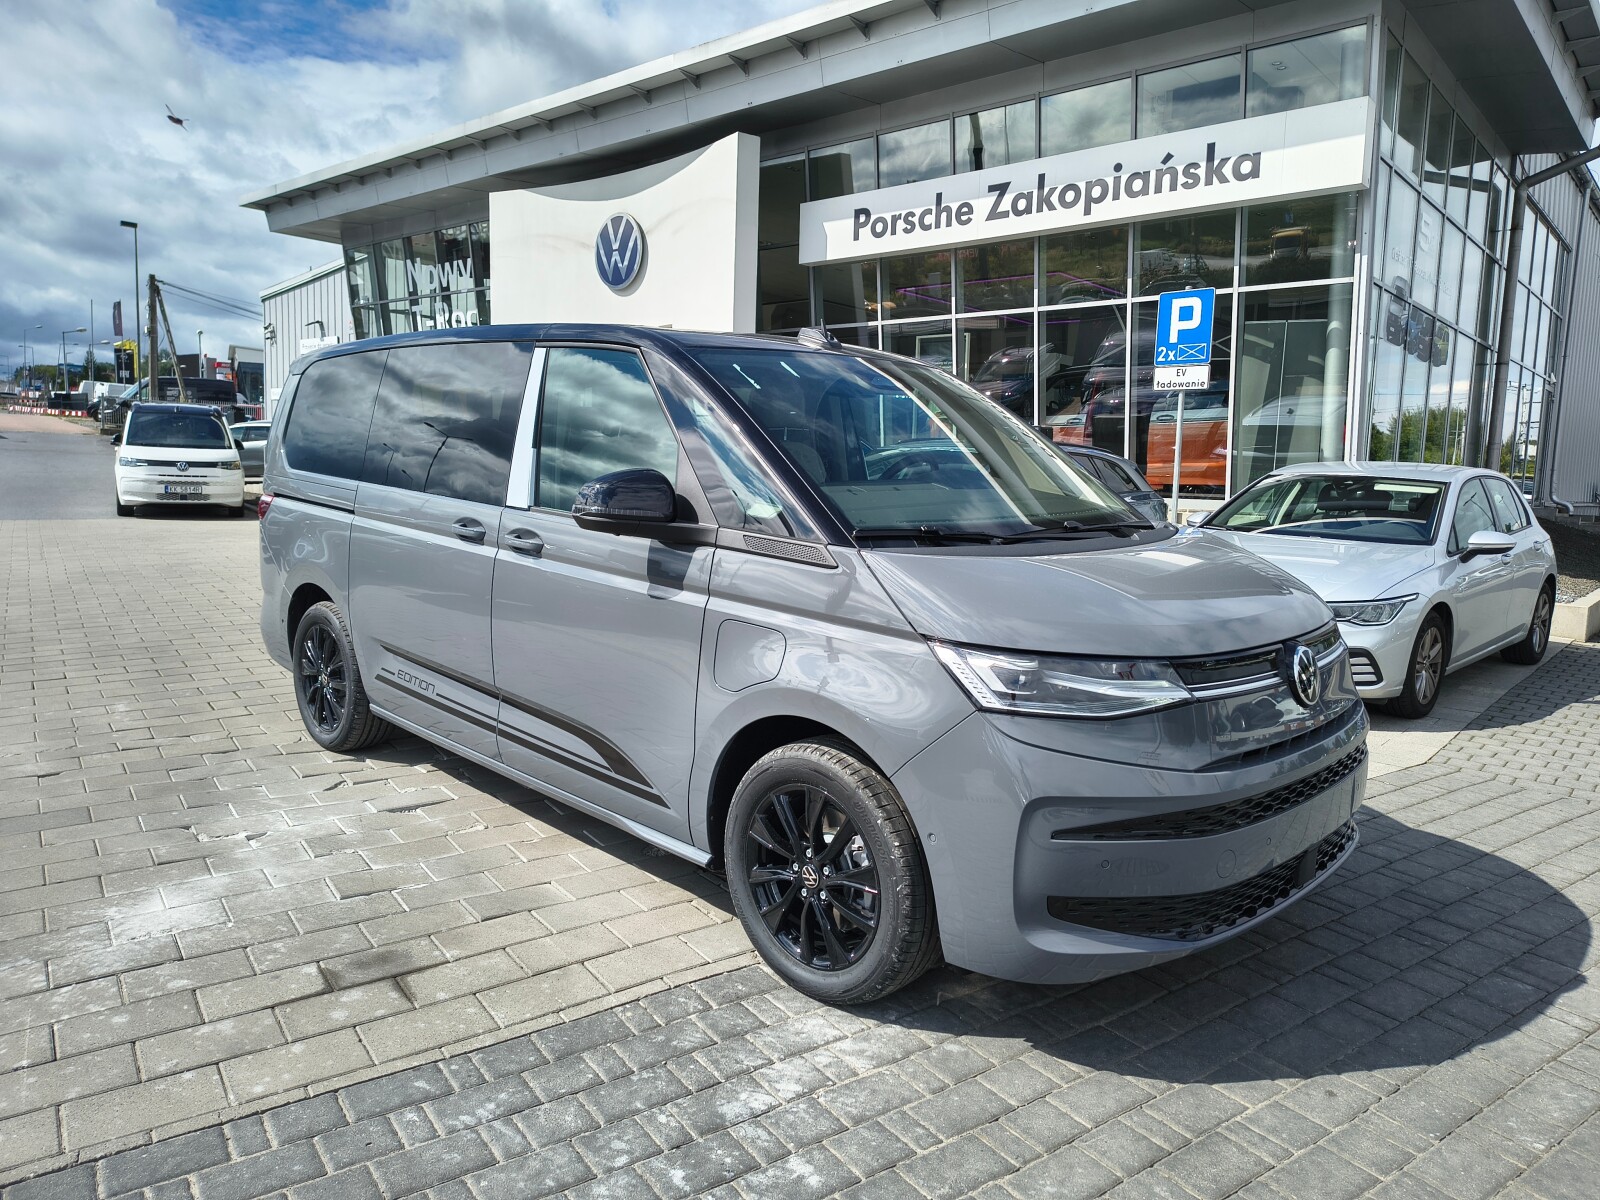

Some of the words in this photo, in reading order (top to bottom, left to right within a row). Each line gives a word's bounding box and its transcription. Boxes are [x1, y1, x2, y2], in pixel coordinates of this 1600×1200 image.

[853, 192, 974, 241] Porsche
[985, 142, 1262, 216] Zakopiańska
[405, 257, 473, 293] Nowy
[1169, 296, 1202, 344] P
[1156, 379, 1206, 389] ładowanie
[1176, 368, 1187, 377] EV
[396, 668, 436, 695] EDITION
